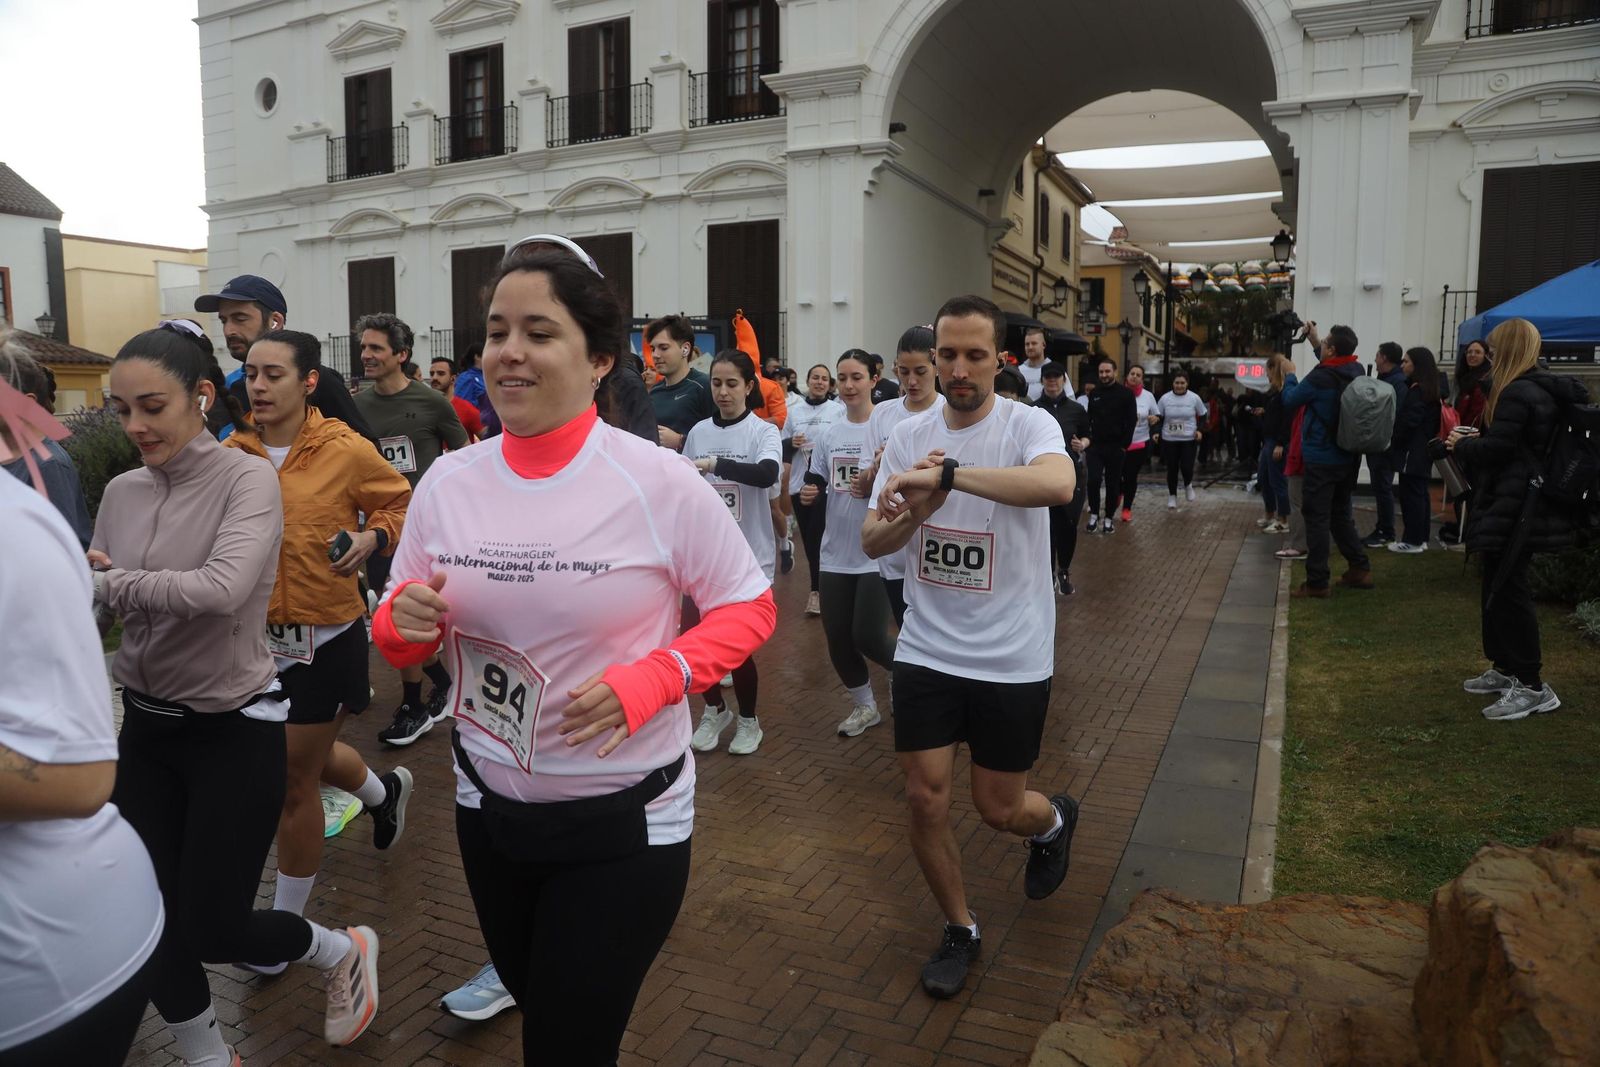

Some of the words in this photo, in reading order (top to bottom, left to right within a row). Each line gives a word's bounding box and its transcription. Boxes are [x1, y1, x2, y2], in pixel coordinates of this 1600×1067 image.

[454, 554, 535, 573] Internacional
[537, 561, 553, 571] de
[555, 561, 570, 572] la
[572, 561, 612, 575] Mujer
[925, 539, 985, 570] 200
[517, 574, 535, 583] 2025
[482, 663, 527, 725] 94
